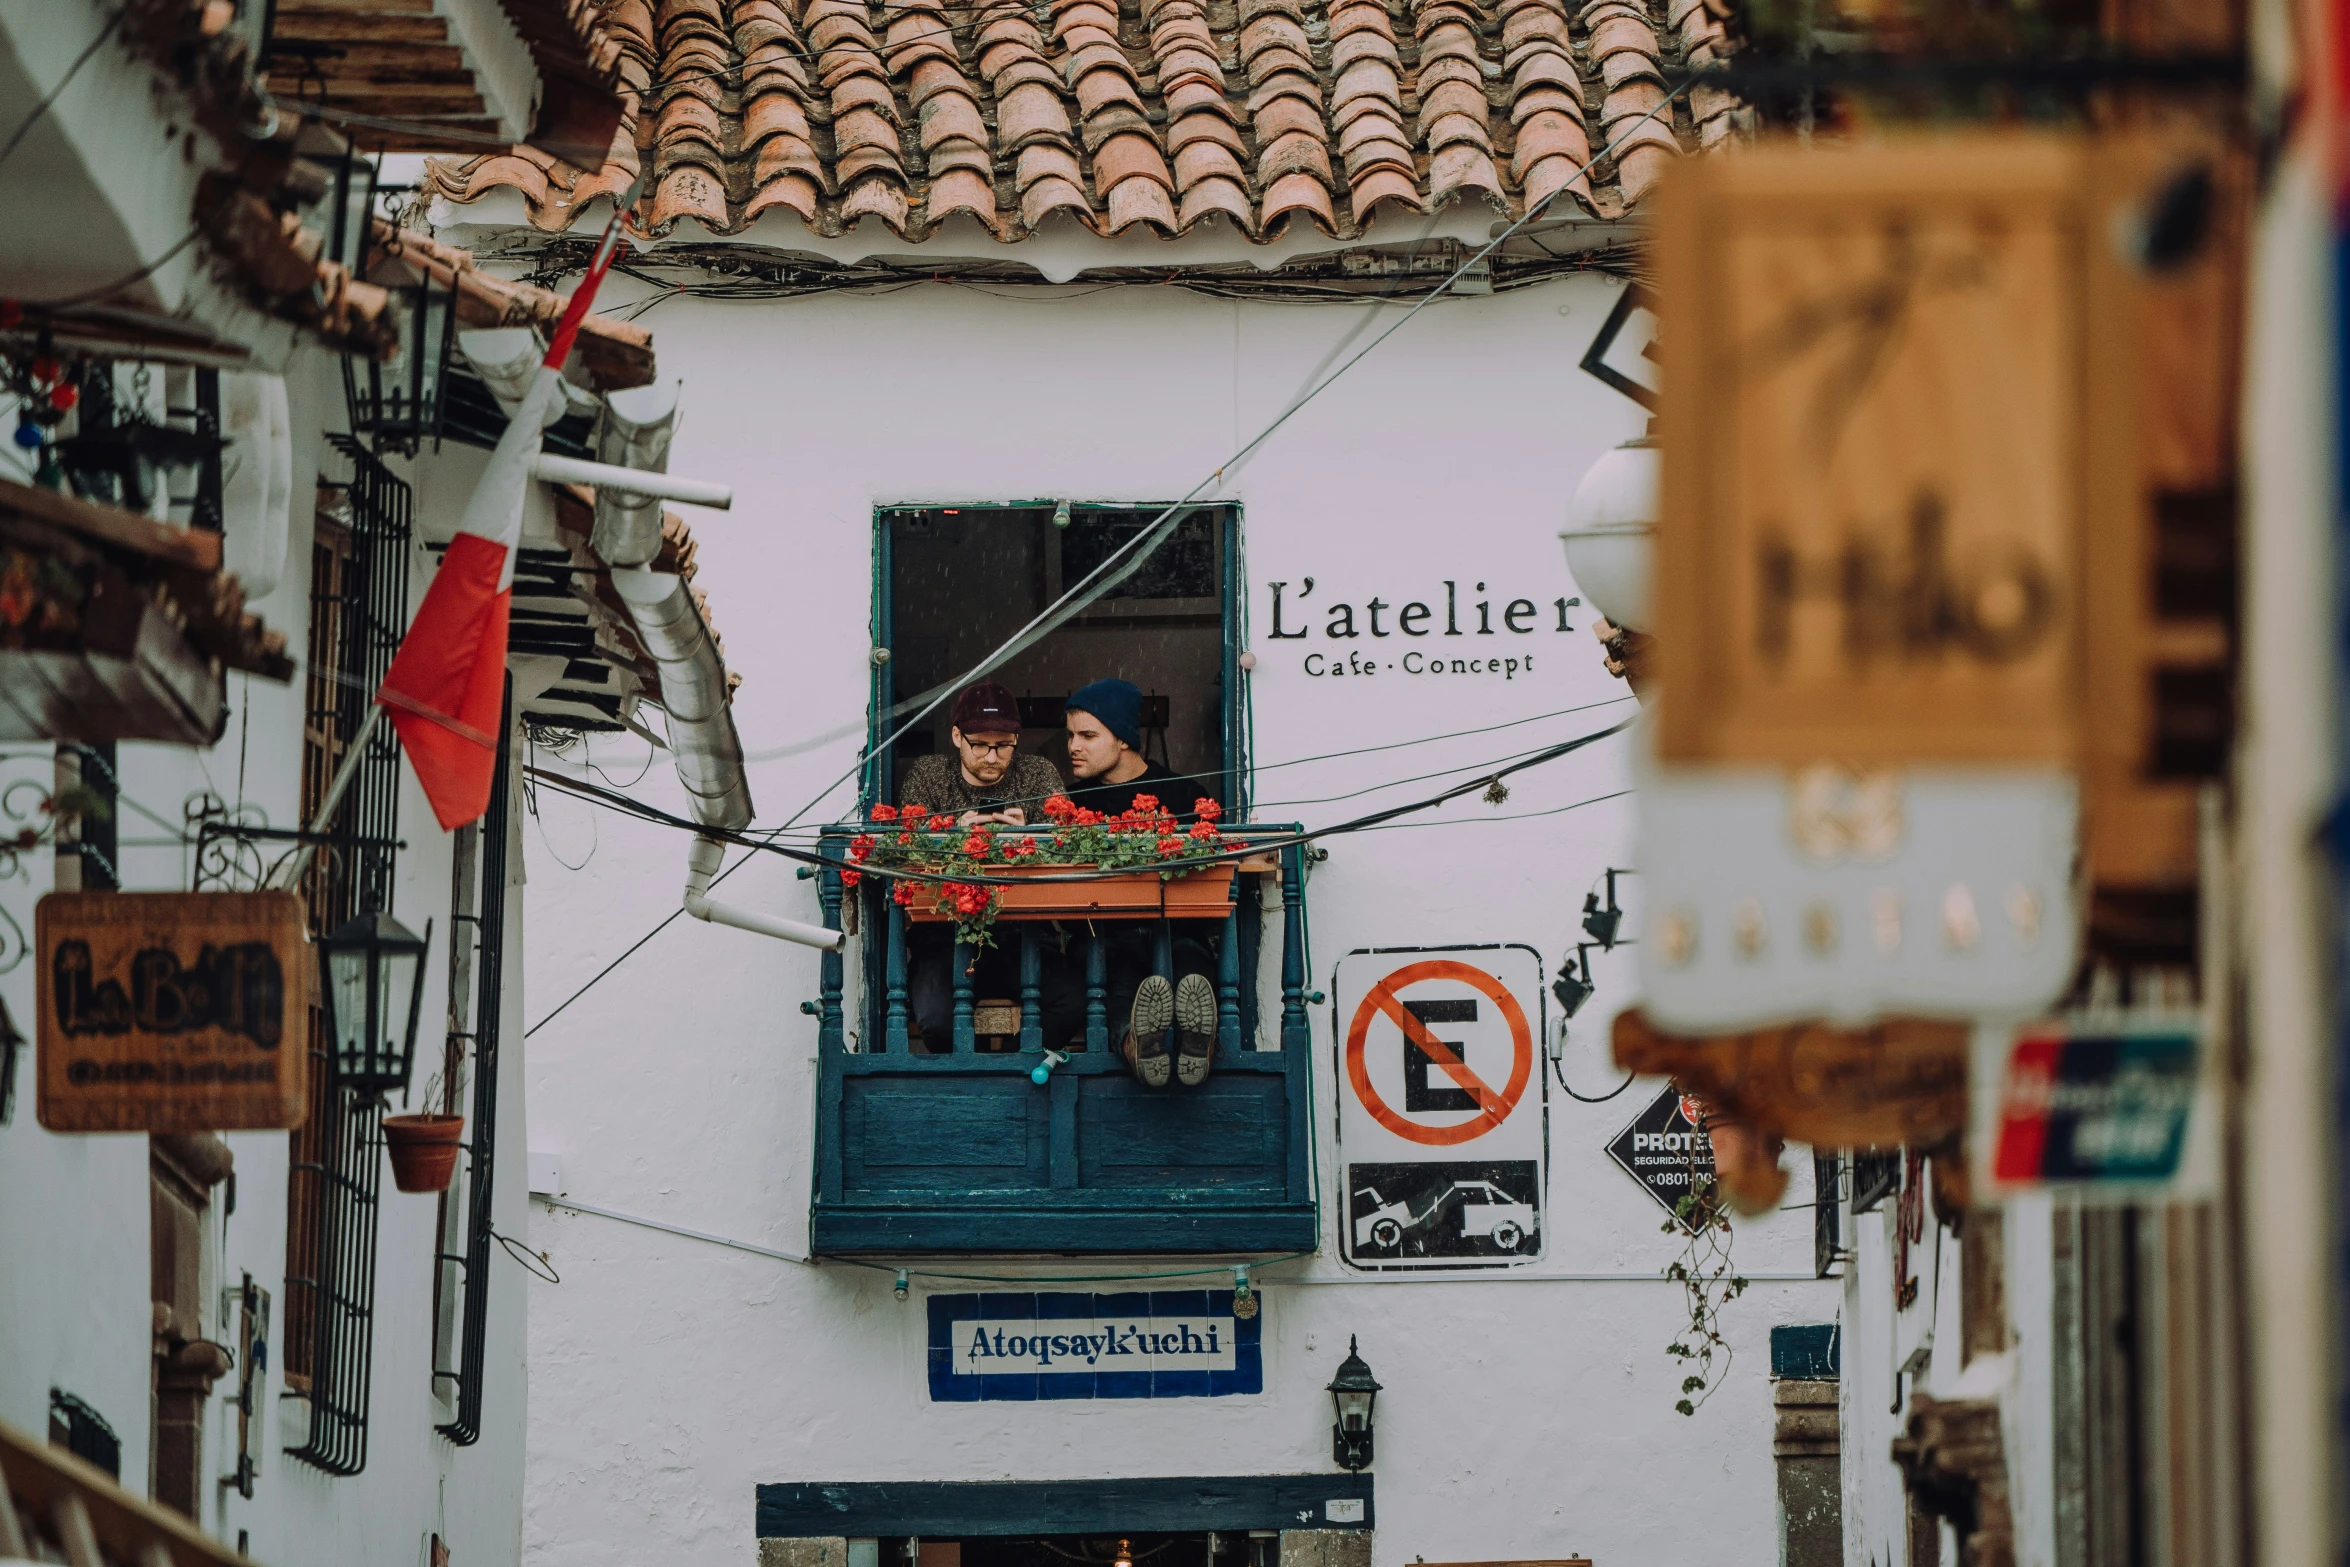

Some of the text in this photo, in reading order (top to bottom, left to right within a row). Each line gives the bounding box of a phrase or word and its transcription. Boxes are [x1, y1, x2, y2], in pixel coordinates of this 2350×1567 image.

[1267, 576, 1580, 639] L'atelier
[1403, 652, 1533, 680] Concept
[1403, 999, 1481, 1112] E
[1633, 1133, 1714, 1151] PROTE
[1634, 1156, 1689, 1165] SEGURIDAD
[968, 1324, 1222, 1365] Atoqsayk'uchi
